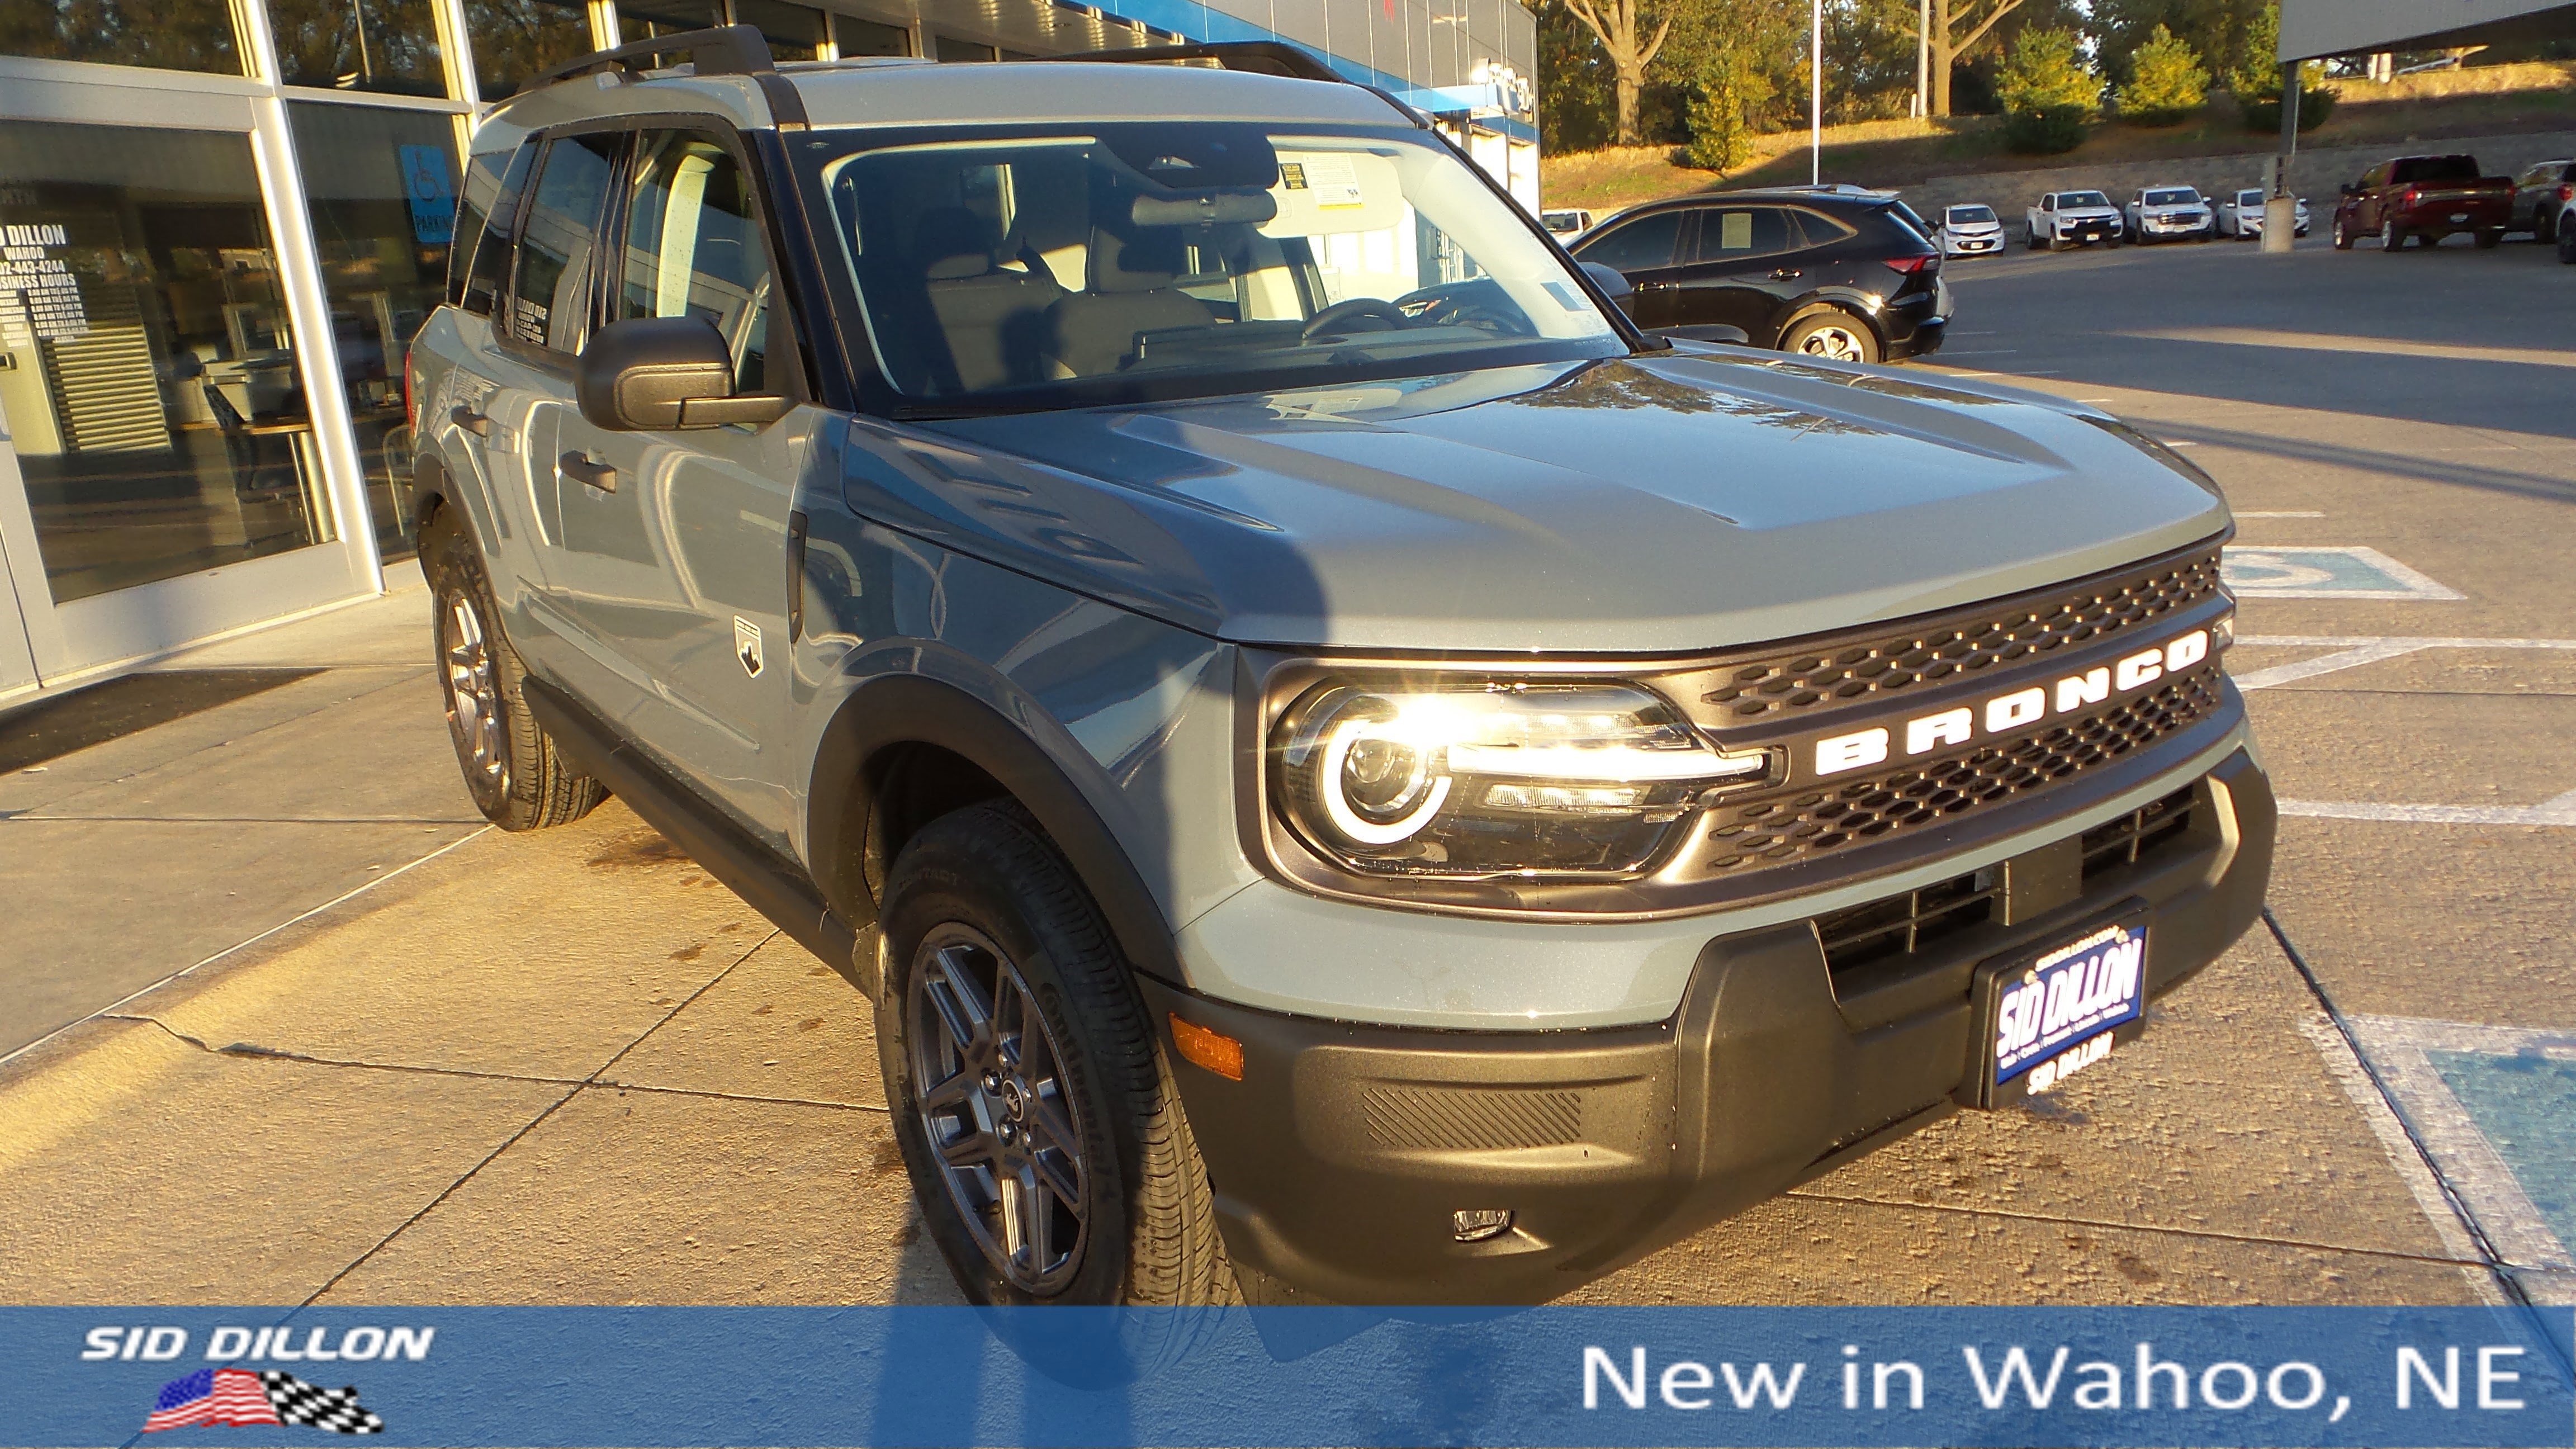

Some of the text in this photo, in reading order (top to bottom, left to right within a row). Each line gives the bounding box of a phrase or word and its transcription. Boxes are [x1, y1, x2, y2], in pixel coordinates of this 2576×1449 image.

[3, 247, 45, 261] WAHOO
[6, 225, 66, 246] DILLON
[0, 273, 76, 290] SINESS HOURS
[1815, 629, 2208, 776] BRONCO
[1996, 937, 2142, 1058] SID DILLON
[2027, 1060, 2057, 1095] SID
[2056, 1031, 2114, 1080] DILLON
